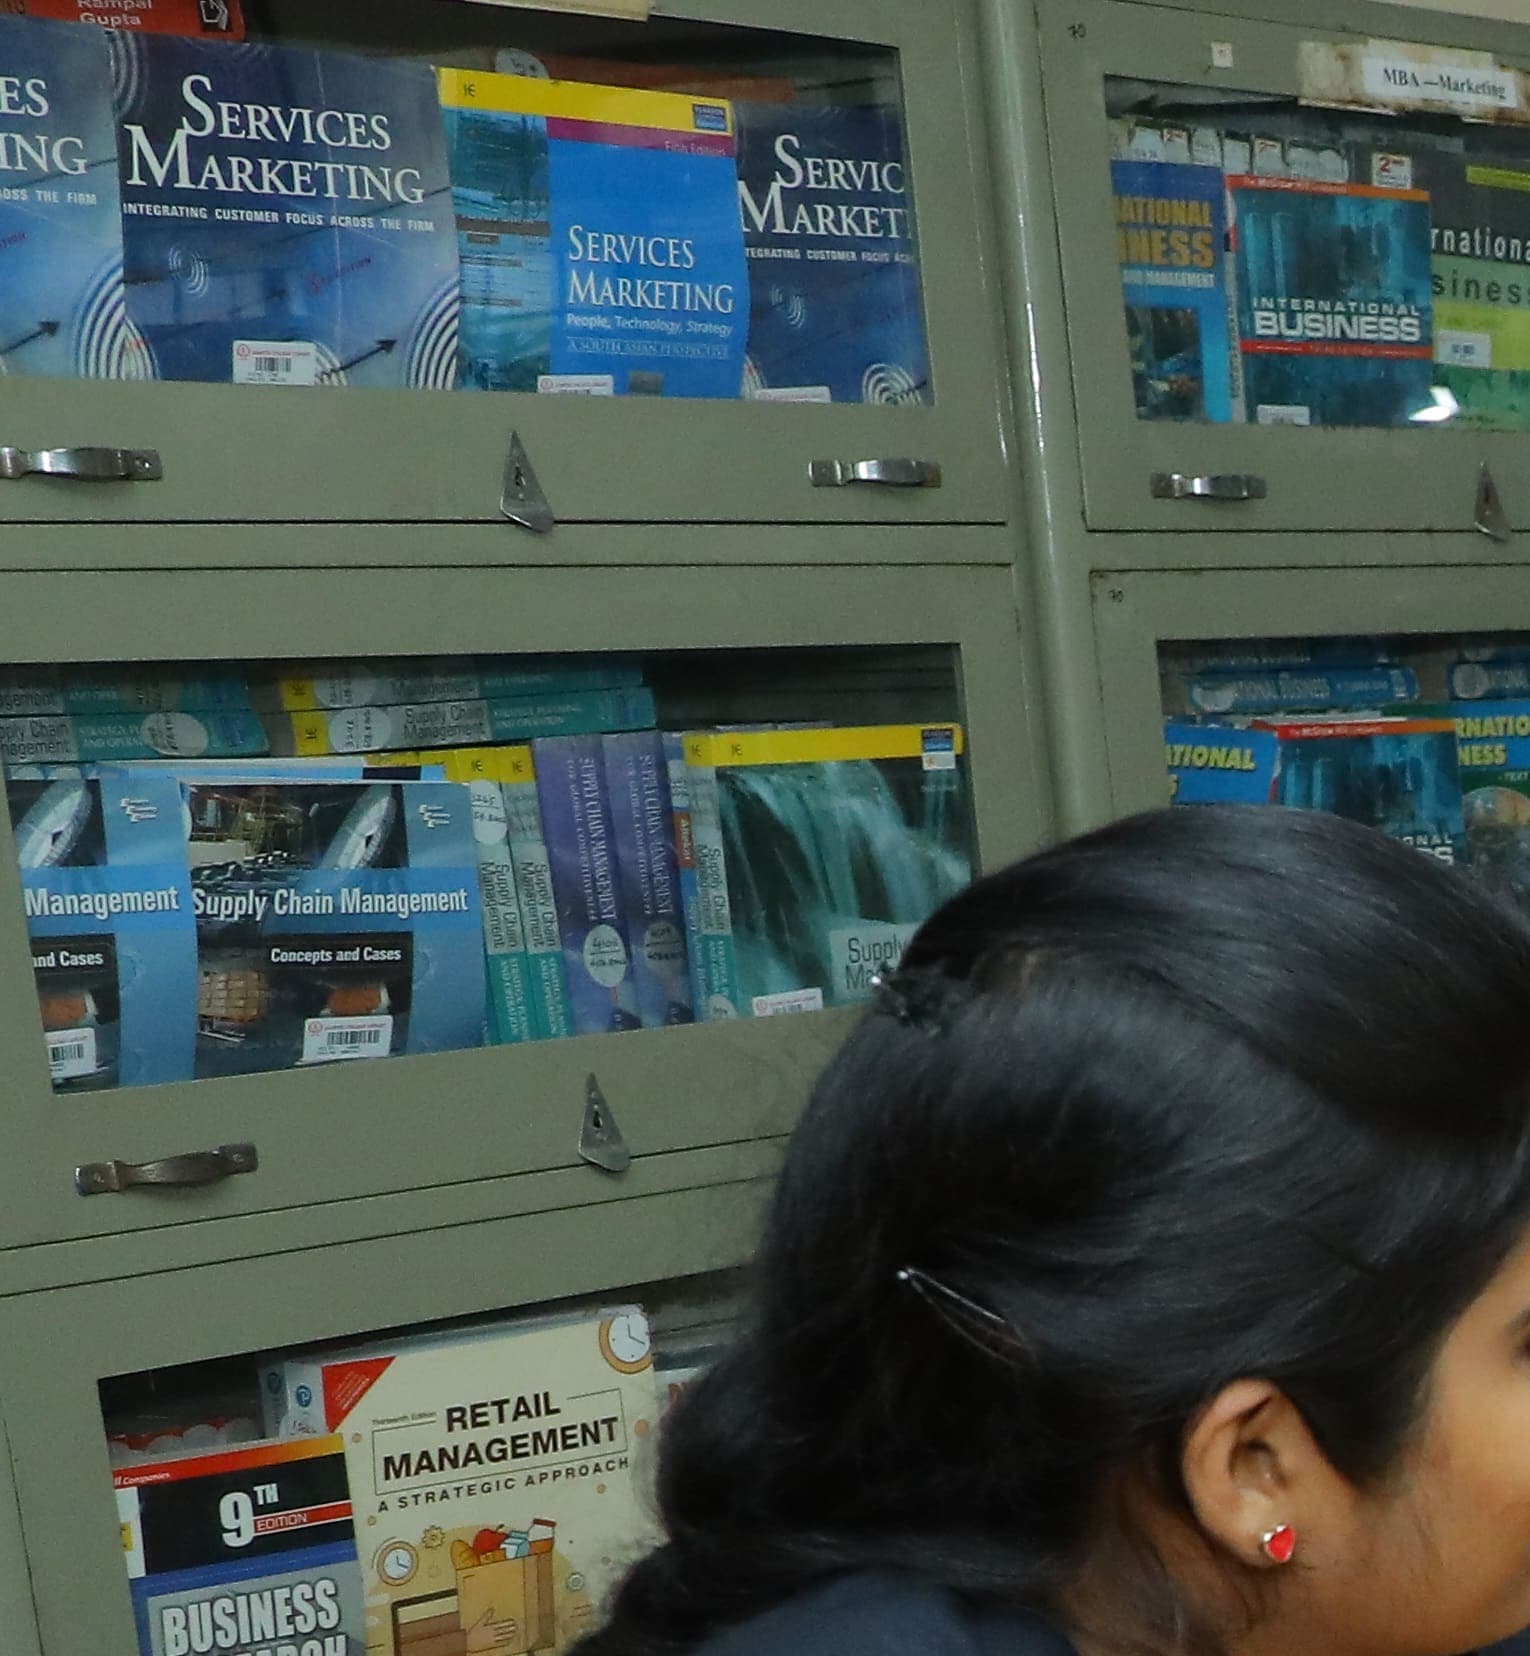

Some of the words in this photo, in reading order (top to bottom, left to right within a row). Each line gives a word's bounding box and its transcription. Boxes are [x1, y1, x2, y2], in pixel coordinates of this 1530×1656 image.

[79, 12, 141, 28] Gupta
[1383, 67, 1420, 88] MBA
[182, 73, 392, 151] SERVICES
[123, 123, 425, 204] MARKETING
[774, 134, 905, 194] SERVIC
[36, 190, 59, 203] THE
[67, 192, 97, 206] FIRM
[738, 181, 906, 240] MARKET
[1115, 194, 1212, 227] NATIONAL
[123, 202, 208, 220] INTEGRATING
[215, 208, 279, 224] CUSTOMER
[286, 212, 325, 227] FOCUS
[330, 214, 374, 230] ACROSS
[380, 217, 401, 231] THE
[408, 218, 435, 232] FIRM
[568, 224, 696, 270] SERVICES
[745, 247, 800, 260] TEGRATING
[806, 249, 857, 262] CUSTOMER
[861, 250, 890, 263] FOCUS
[1119, 228, 1214, 269] INESS
[567, 269, 734, 314] MARKETING
[1253, 296, 1420, 317] INTERNATIONAL
[567, 313, 611, 329] People,
[686, 320, 732, 338] Strategy
[1254, 311, 1421, 343] BUSINESS
[0, 725, 25, 739] pply
[404, 721, 485, 742] Management
[406, 708, 446, 729] Supply
[0, 741, 69, 760] nagement
[1167, 744, 1256, 772] ATIONAL
[1457, 744, 1508, 767] NESS
[580, 758, 600, 798] SUPPLY
[586, 802, 606, 838] CHAIN
[495, 864, 512, 907] Supply
[534, 864, 551, 907] Supply
[591, 841, 616, 920] MANAGEMENT
[708, 848, 724, 889] Supply
[25, 886, 180, 920] Management
[193, 888, 268, 923] Supply
[273, 889, 335, 916] Chain
[340, 886, 469, 920] Management
[479, 862, 502, 948] Management
[521, 862, 543, 947] Management
[502, 911, 520, 947] Chain
[541, 912, 555, 947] Chain
[60, 950, 104, 967] Cases
[270, 947, 332, 964] Concepts
[335, 946, 359, 963] and
[363, 946, 402, 962] Cases
[446, 1391, 562, 1433] RETAIL
[383, 1416, 619, 1481] MANAGEMENT
[378, 1500, 389, 1513] A
[398, 1477, 517, 1509] STRATEGIC
[524, 1457, 630, 1487] APPROACH
[218, 1490, 255, 1548] 9
[253, 1482, 281, 1506] TH
[256, 1512, 309, 1533] EDITION
